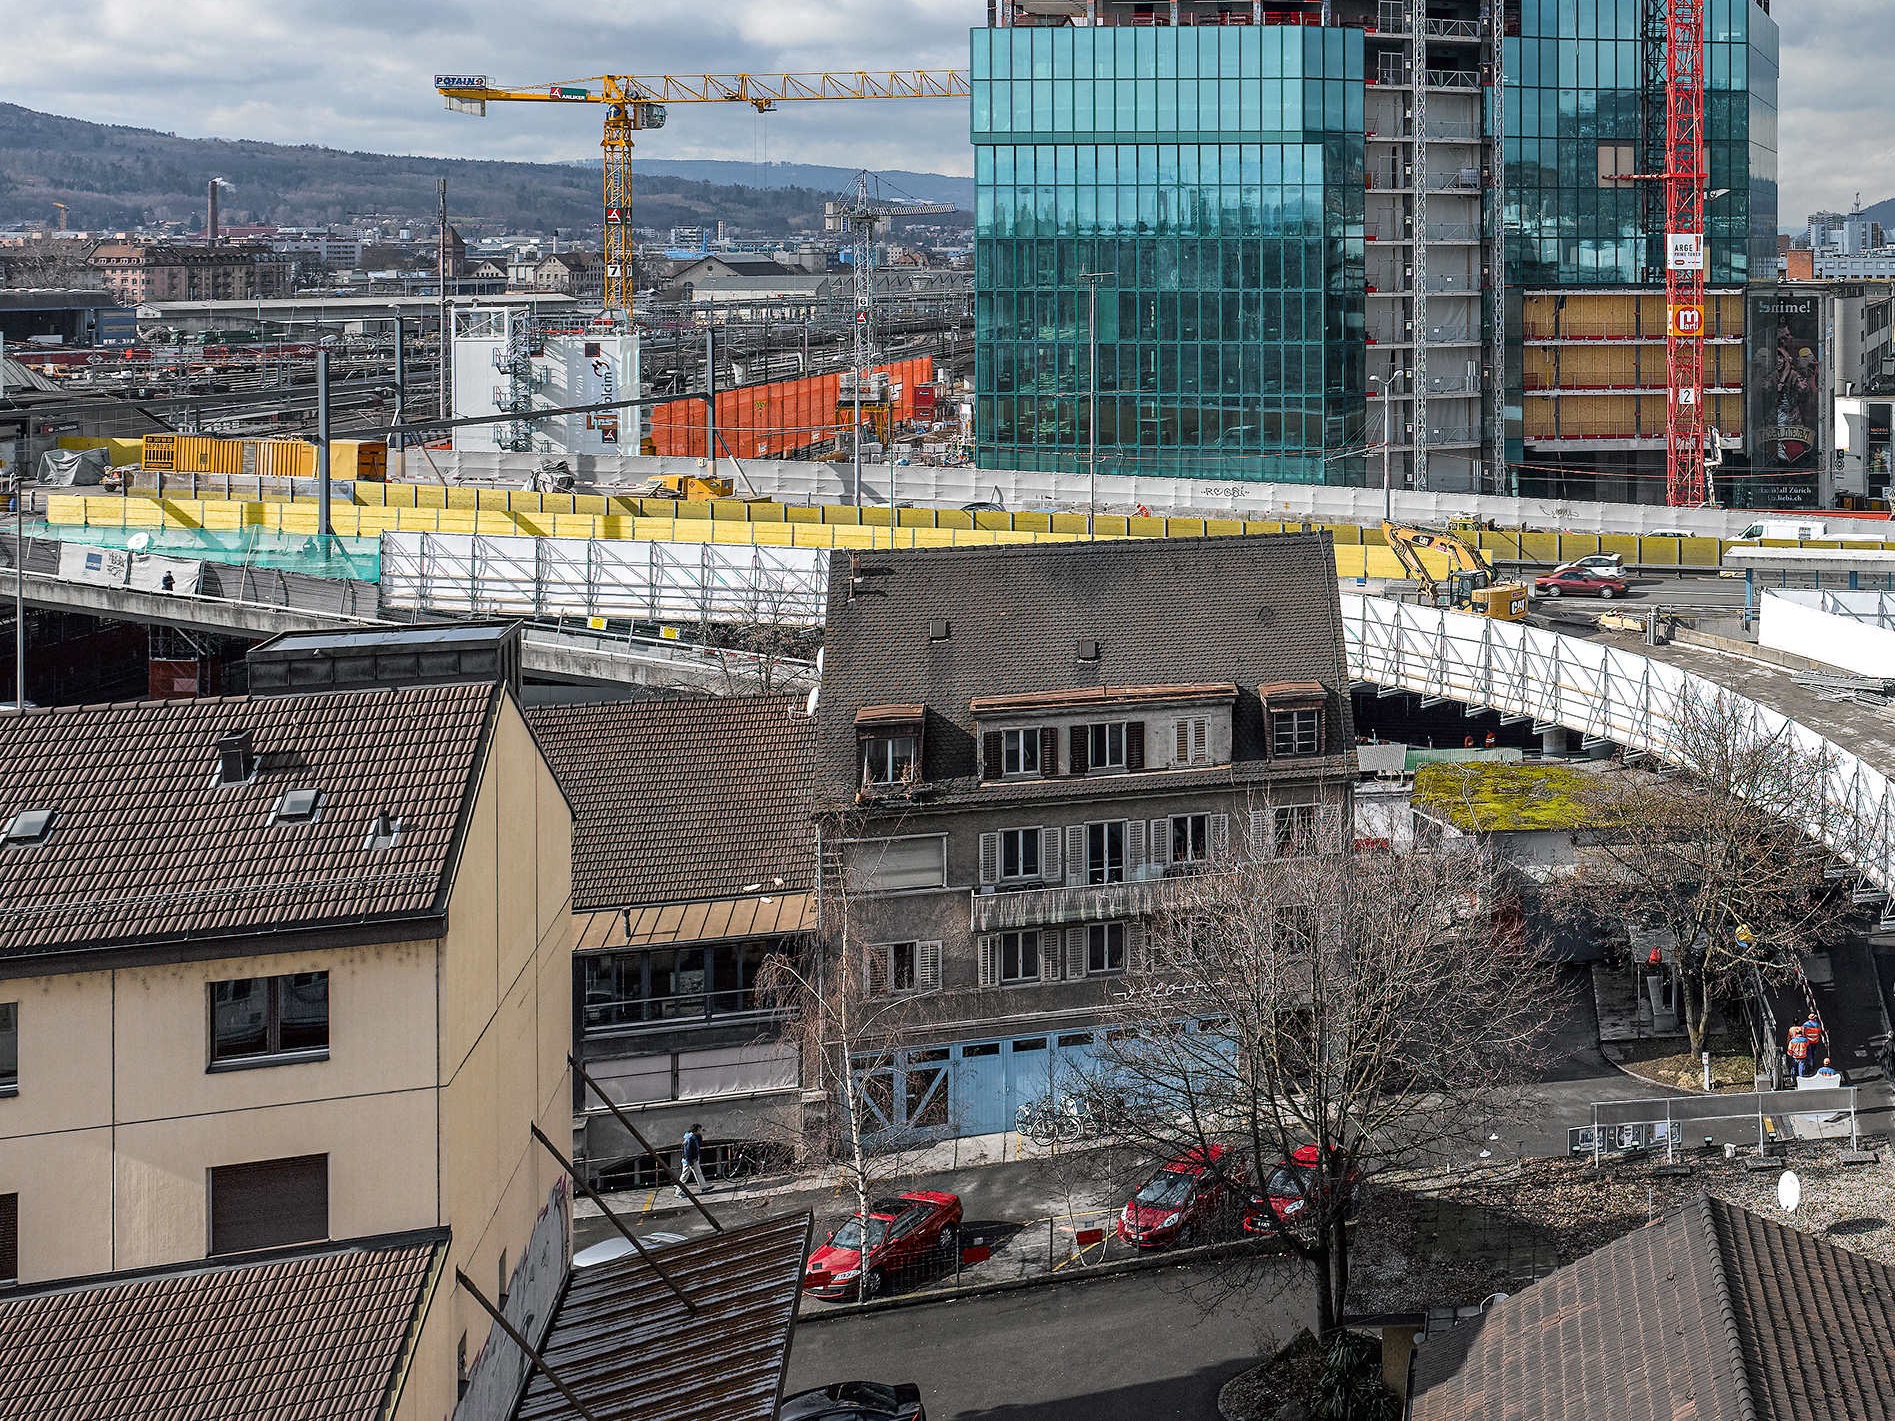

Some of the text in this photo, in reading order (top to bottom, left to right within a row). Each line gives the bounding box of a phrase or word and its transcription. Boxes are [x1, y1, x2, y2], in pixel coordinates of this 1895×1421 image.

[436, 77, 475, 86] POTAIN
[1674, 244, 1693, 252] ARGE
[609, 265, 618, 276] 7
[860, 298, 867, 306] 6
[1683, 389, 1691, 403] 2
[1419, 535, 1430, 546] CAT
[1511, 598, 1526, 614] CAT
